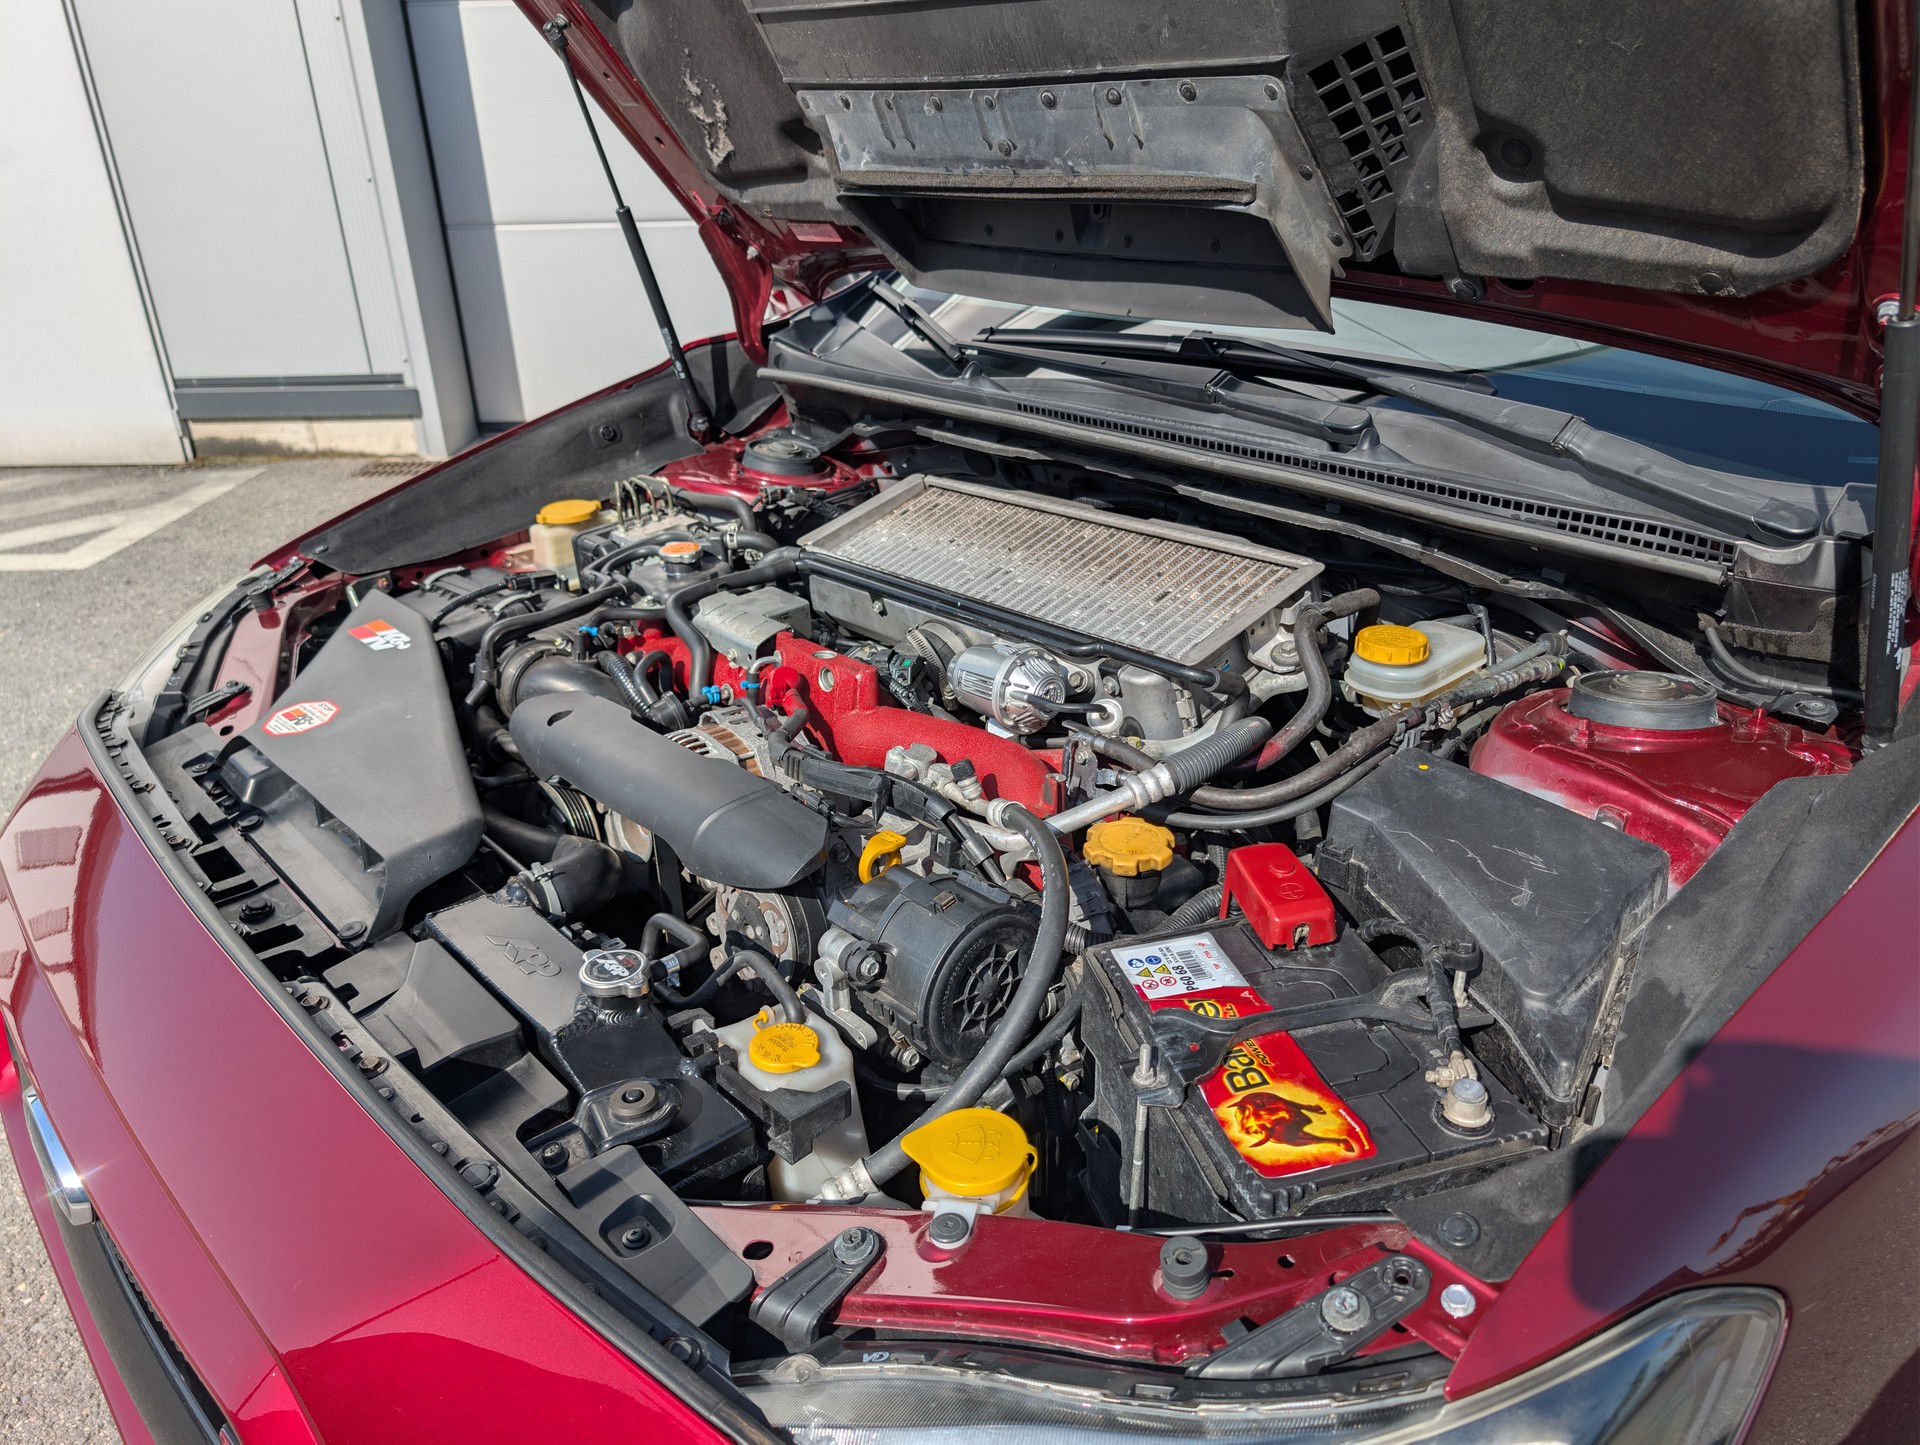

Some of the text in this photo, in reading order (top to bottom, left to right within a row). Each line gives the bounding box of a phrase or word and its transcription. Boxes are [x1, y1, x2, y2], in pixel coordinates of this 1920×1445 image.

[359, 627, 411, 651] K&N
[1172, 965, 1199, 991] P60 68
